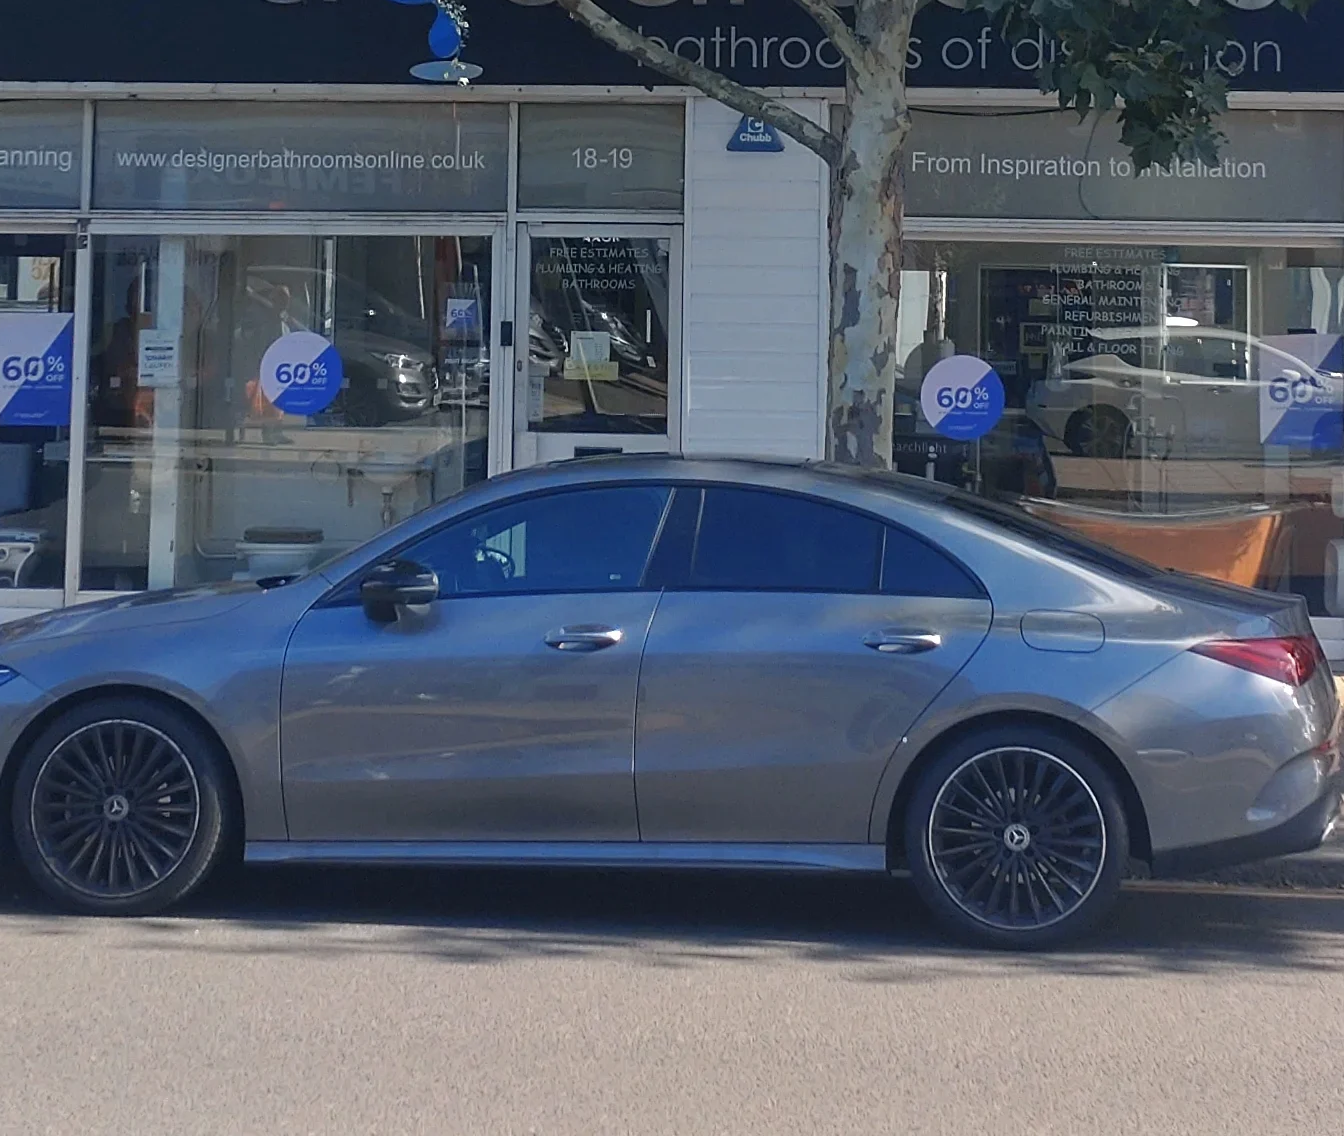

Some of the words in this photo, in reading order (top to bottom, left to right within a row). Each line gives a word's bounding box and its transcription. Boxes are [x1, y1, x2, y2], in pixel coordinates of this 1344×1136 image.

[637, 25, 922, 70] bathroos
[941, 27, 993, 70] of
[739, 133, 772, 142] Chubb
[117, 148, 485, 172] www.designerbathroomsonline.co.uk
[571, 147, 633, 168] 18-19
[911, 152, 971, 174] From
[980, 153, 1101, 180] Inspiration
[1109, 157, 1131, 178] to
[1138, 155, 1267, 179] nstallation
[550, 248, 577, 258] FREE
[581, 248, 649, 258] ESTIMATES
[1064, 248, 1092, 258] FREE
[1096, 248, 1166, 260] ESTIMATES
[536, 264, 595, 274] PLUMBING
[597, 264, 605, 274] &
[609, 264, 662, 275] HEATING
[1050, 264, 1111, 274] PLUMBING
[1125, 265, 1181, 276] HEATNG
[562, 280, 636, 290] BATHROOMS
[1078, 280, 1153, 291] BATHROOMS
[1043, 295, 1095, 305] GENERAL
[1098, 295, 1188, 307] MAINTENNC
[1064, 310, 1165, 323] REFURBISHMEN
[1041, 325, 1102, 336] PAINTIN
[1087, 343, 1095, 353] &
[1098, 344, 1137, 355] FLOOR
[2, 356, 65, 382] 60%
[275, 362, 327, 384] 60%
[46, 374, 65, 382] OFF
[311, 377, 327, 385] OFF
[937, 387, 989, 409] 60%
